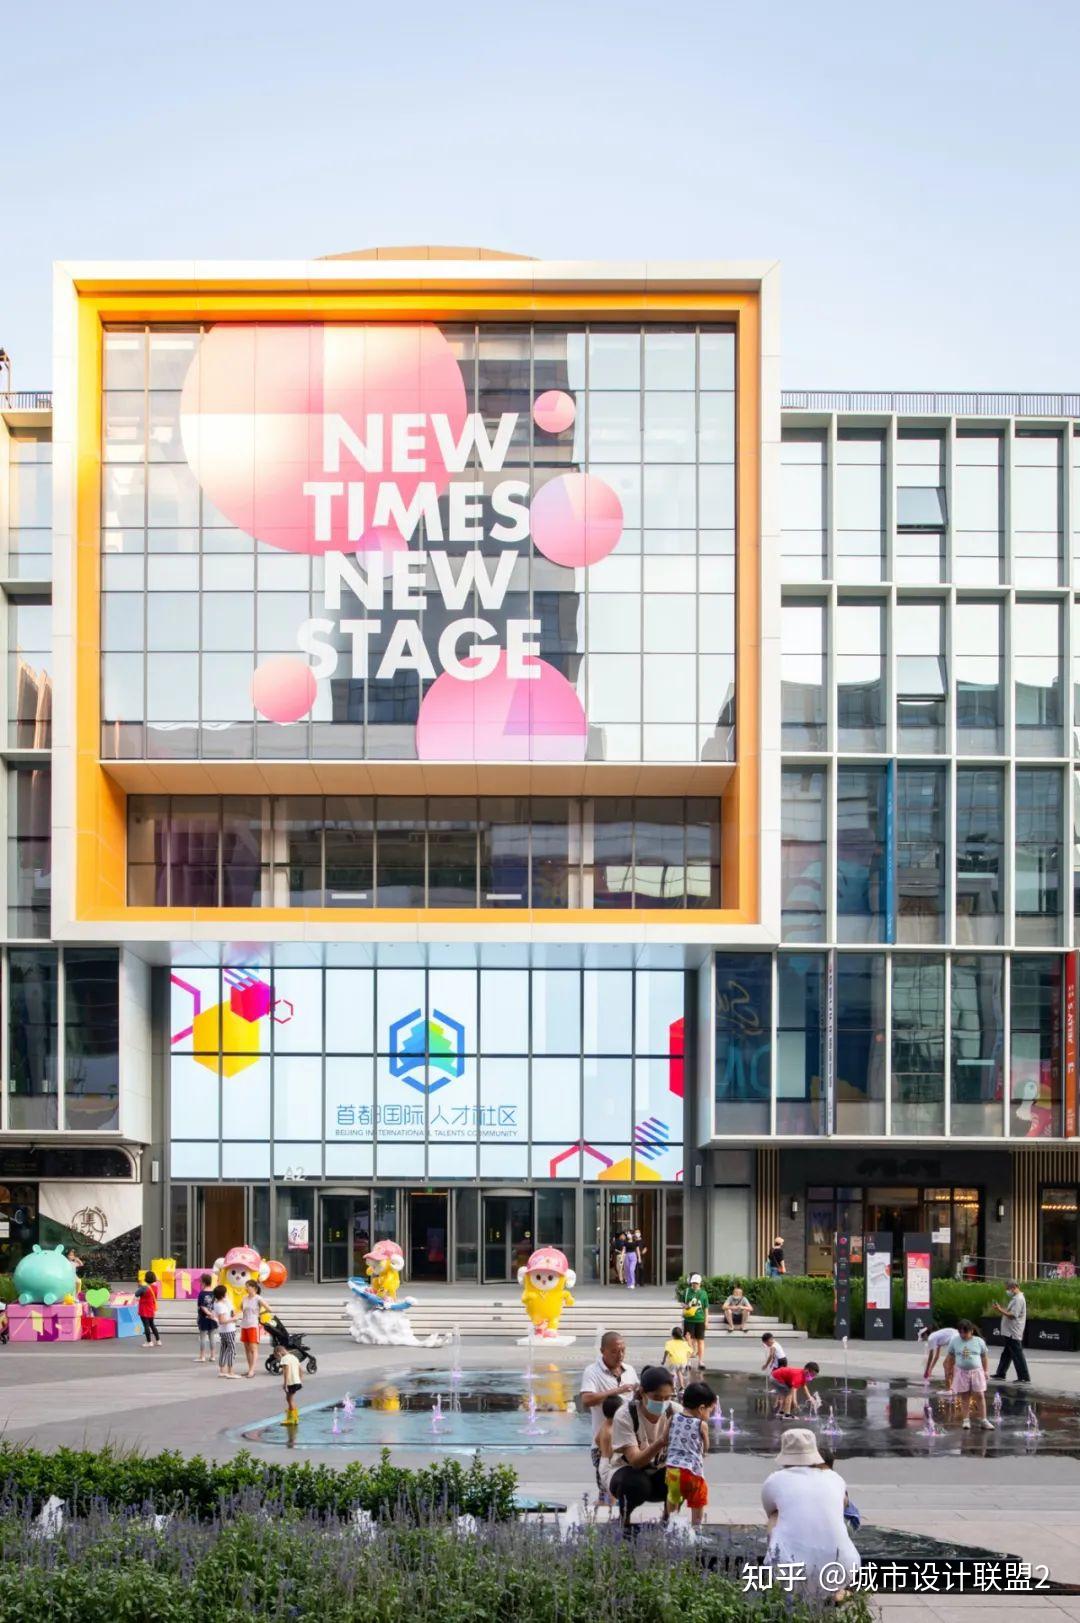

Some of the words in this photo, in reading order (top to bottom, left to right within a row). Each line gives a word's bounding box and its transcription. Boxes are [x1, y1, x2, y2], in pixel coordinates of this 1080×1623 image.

[322, 413, 520, 473] NEW
[302, 480, 530, 542] TIMES
[323, 550, 519, 610] NEW
[296, 617, 542, 681] STAGE
[335, 1129, 364, 1137] BEIJING
[434, 1129, 465, 1138] TALENTS
[467, 1129, 517, 1138] COMMUNITY
[336, 1104, 518, 1126] 首都国际人才社区
[283, 1165, 306, 1181] A2
